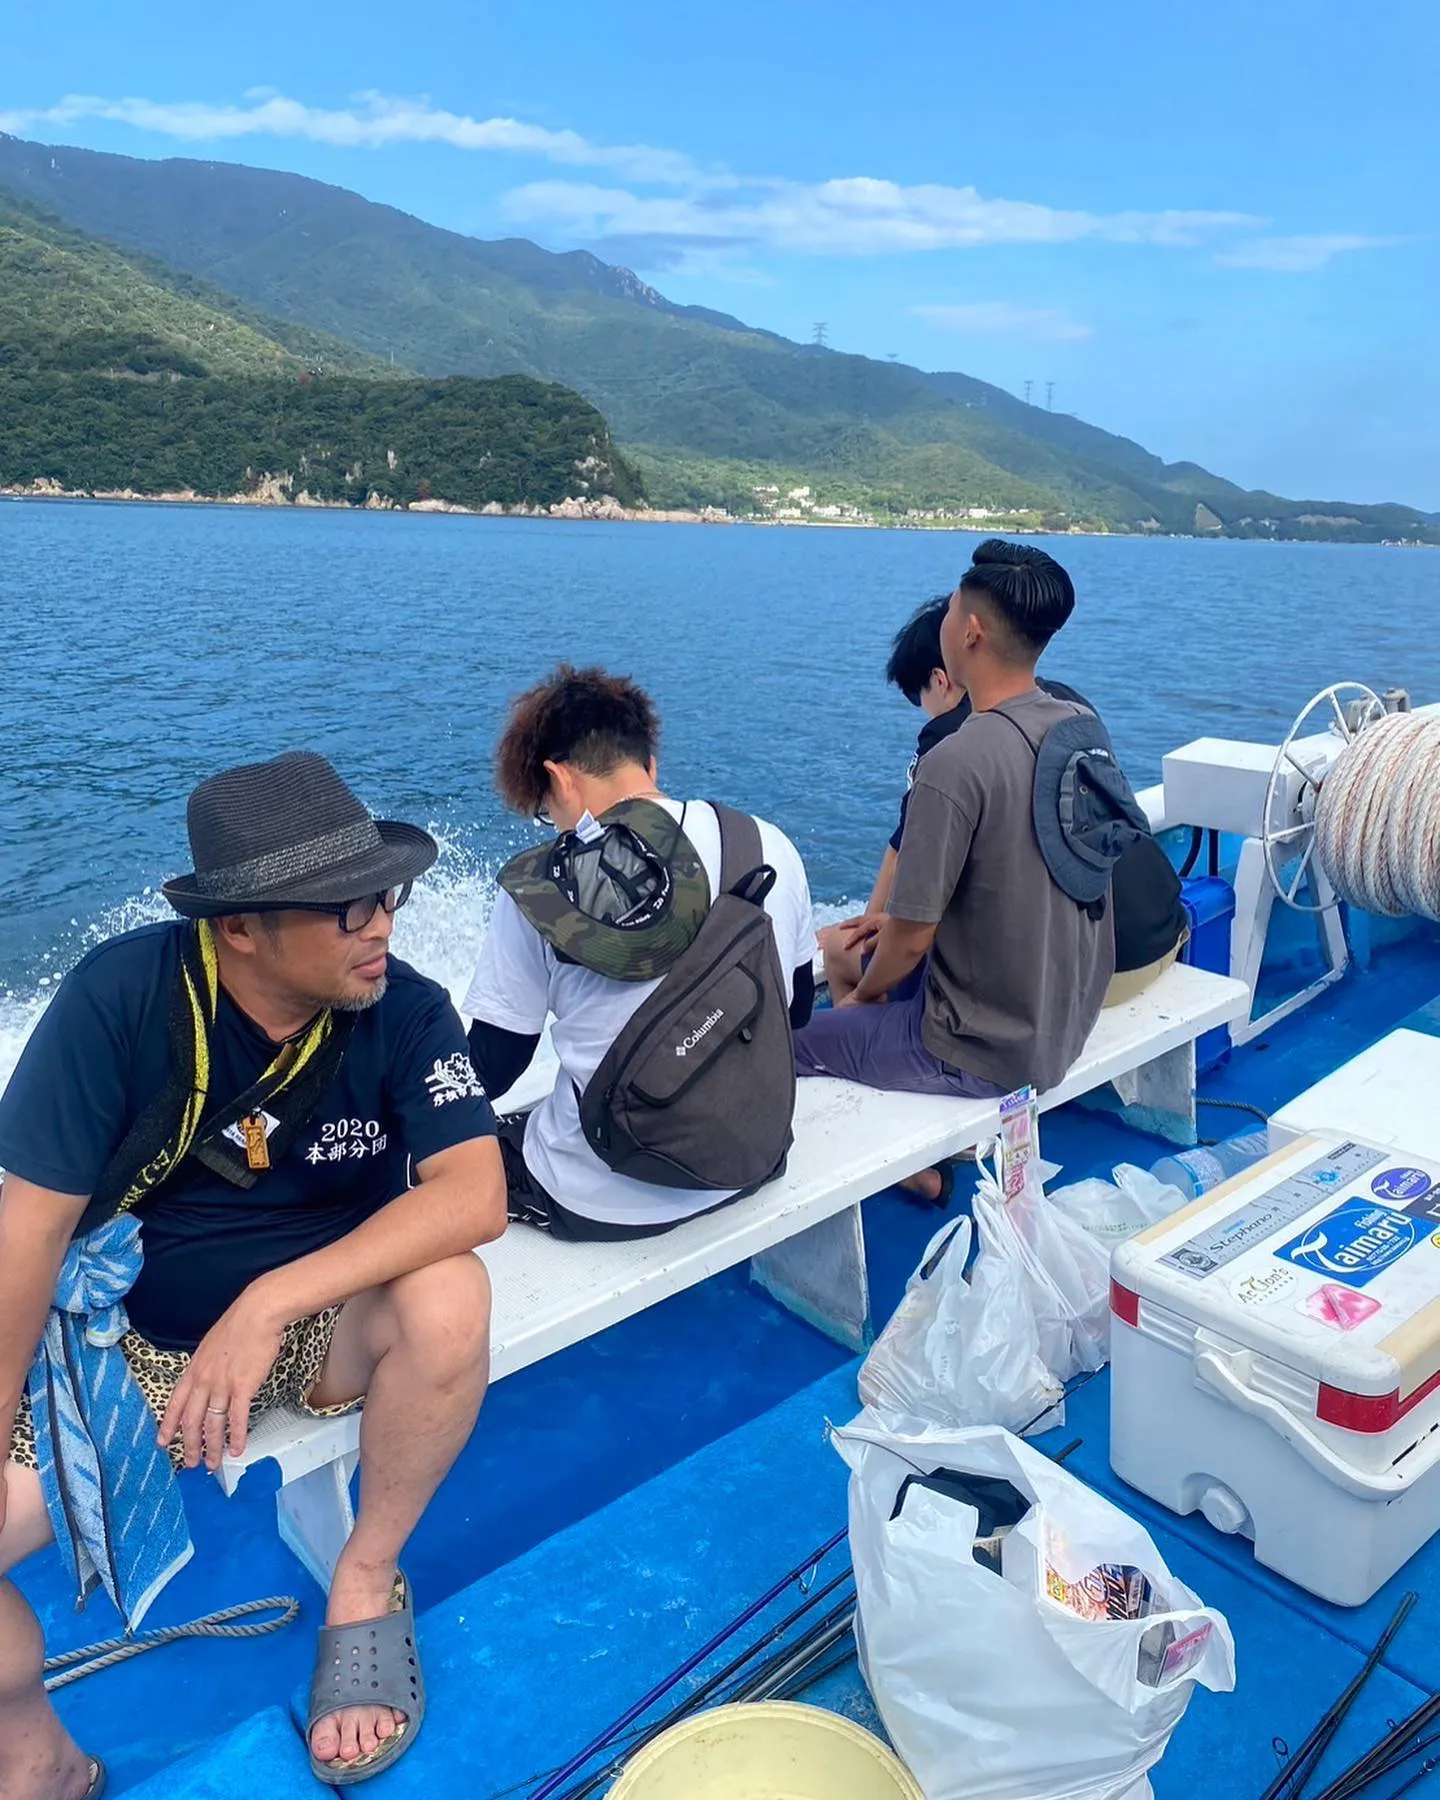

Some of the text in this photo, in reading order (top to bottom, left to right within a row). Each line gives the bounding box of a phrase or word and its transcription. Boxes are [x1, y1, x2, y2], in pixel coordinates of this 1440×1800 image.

[683, 1008, 724, 1048] Columbia
[304, 1134, 387, 1165] 本部分団
[321, 1118, 379, 1142] 2020
[1209, 1213, 1273, 1252] Stephano
[1291, 1211, 1412, 1273] Taimaru
